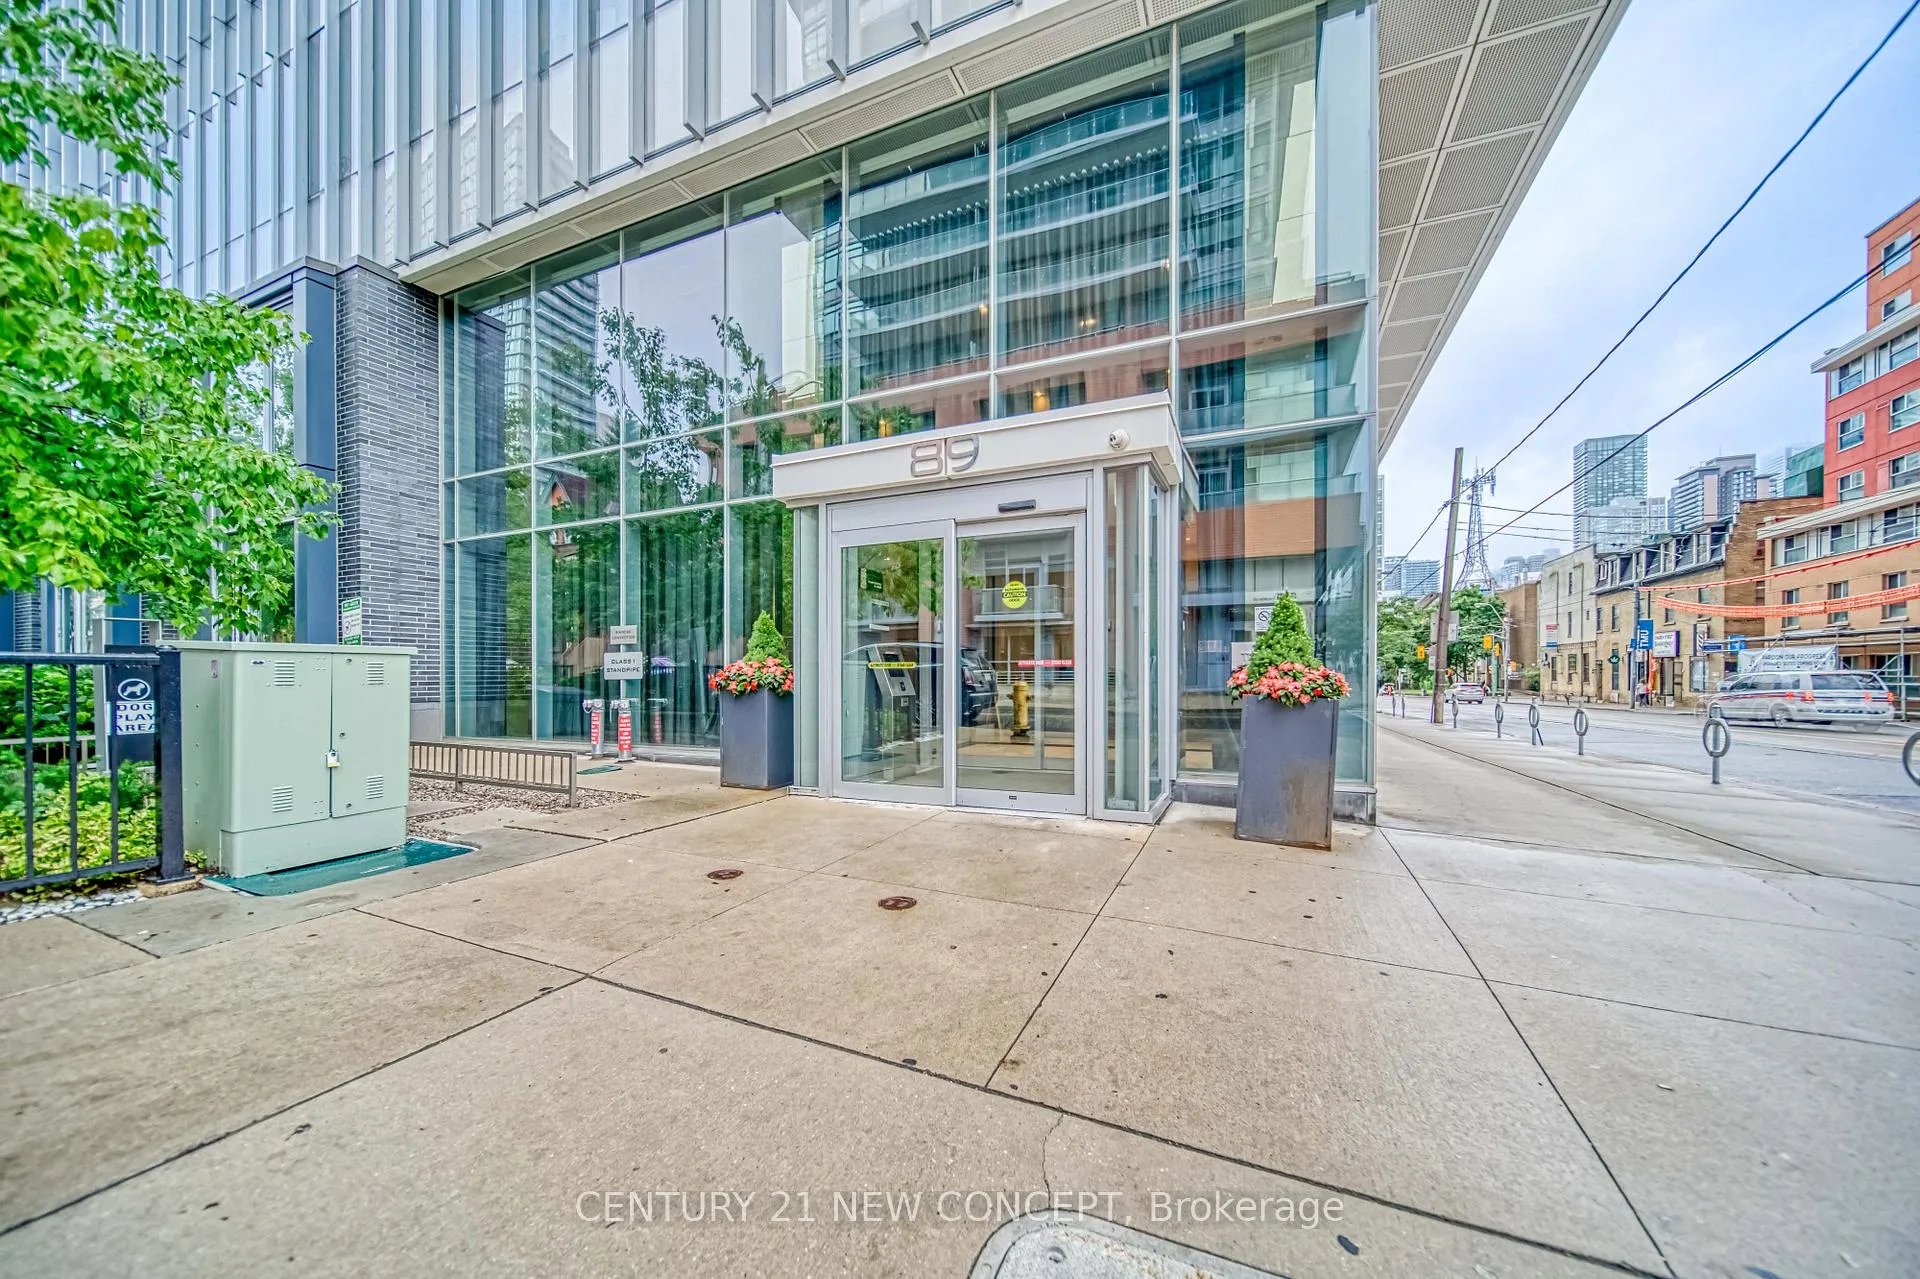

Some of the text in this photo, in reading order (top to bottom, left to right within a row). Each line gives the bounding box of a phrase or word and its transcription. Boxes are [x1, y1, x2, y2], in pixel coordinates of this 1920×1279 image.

[910, 433, 980, 478] 89
[1640, 630, 1649, 647] TMU
[116, 713, 155, 722] PLAY
